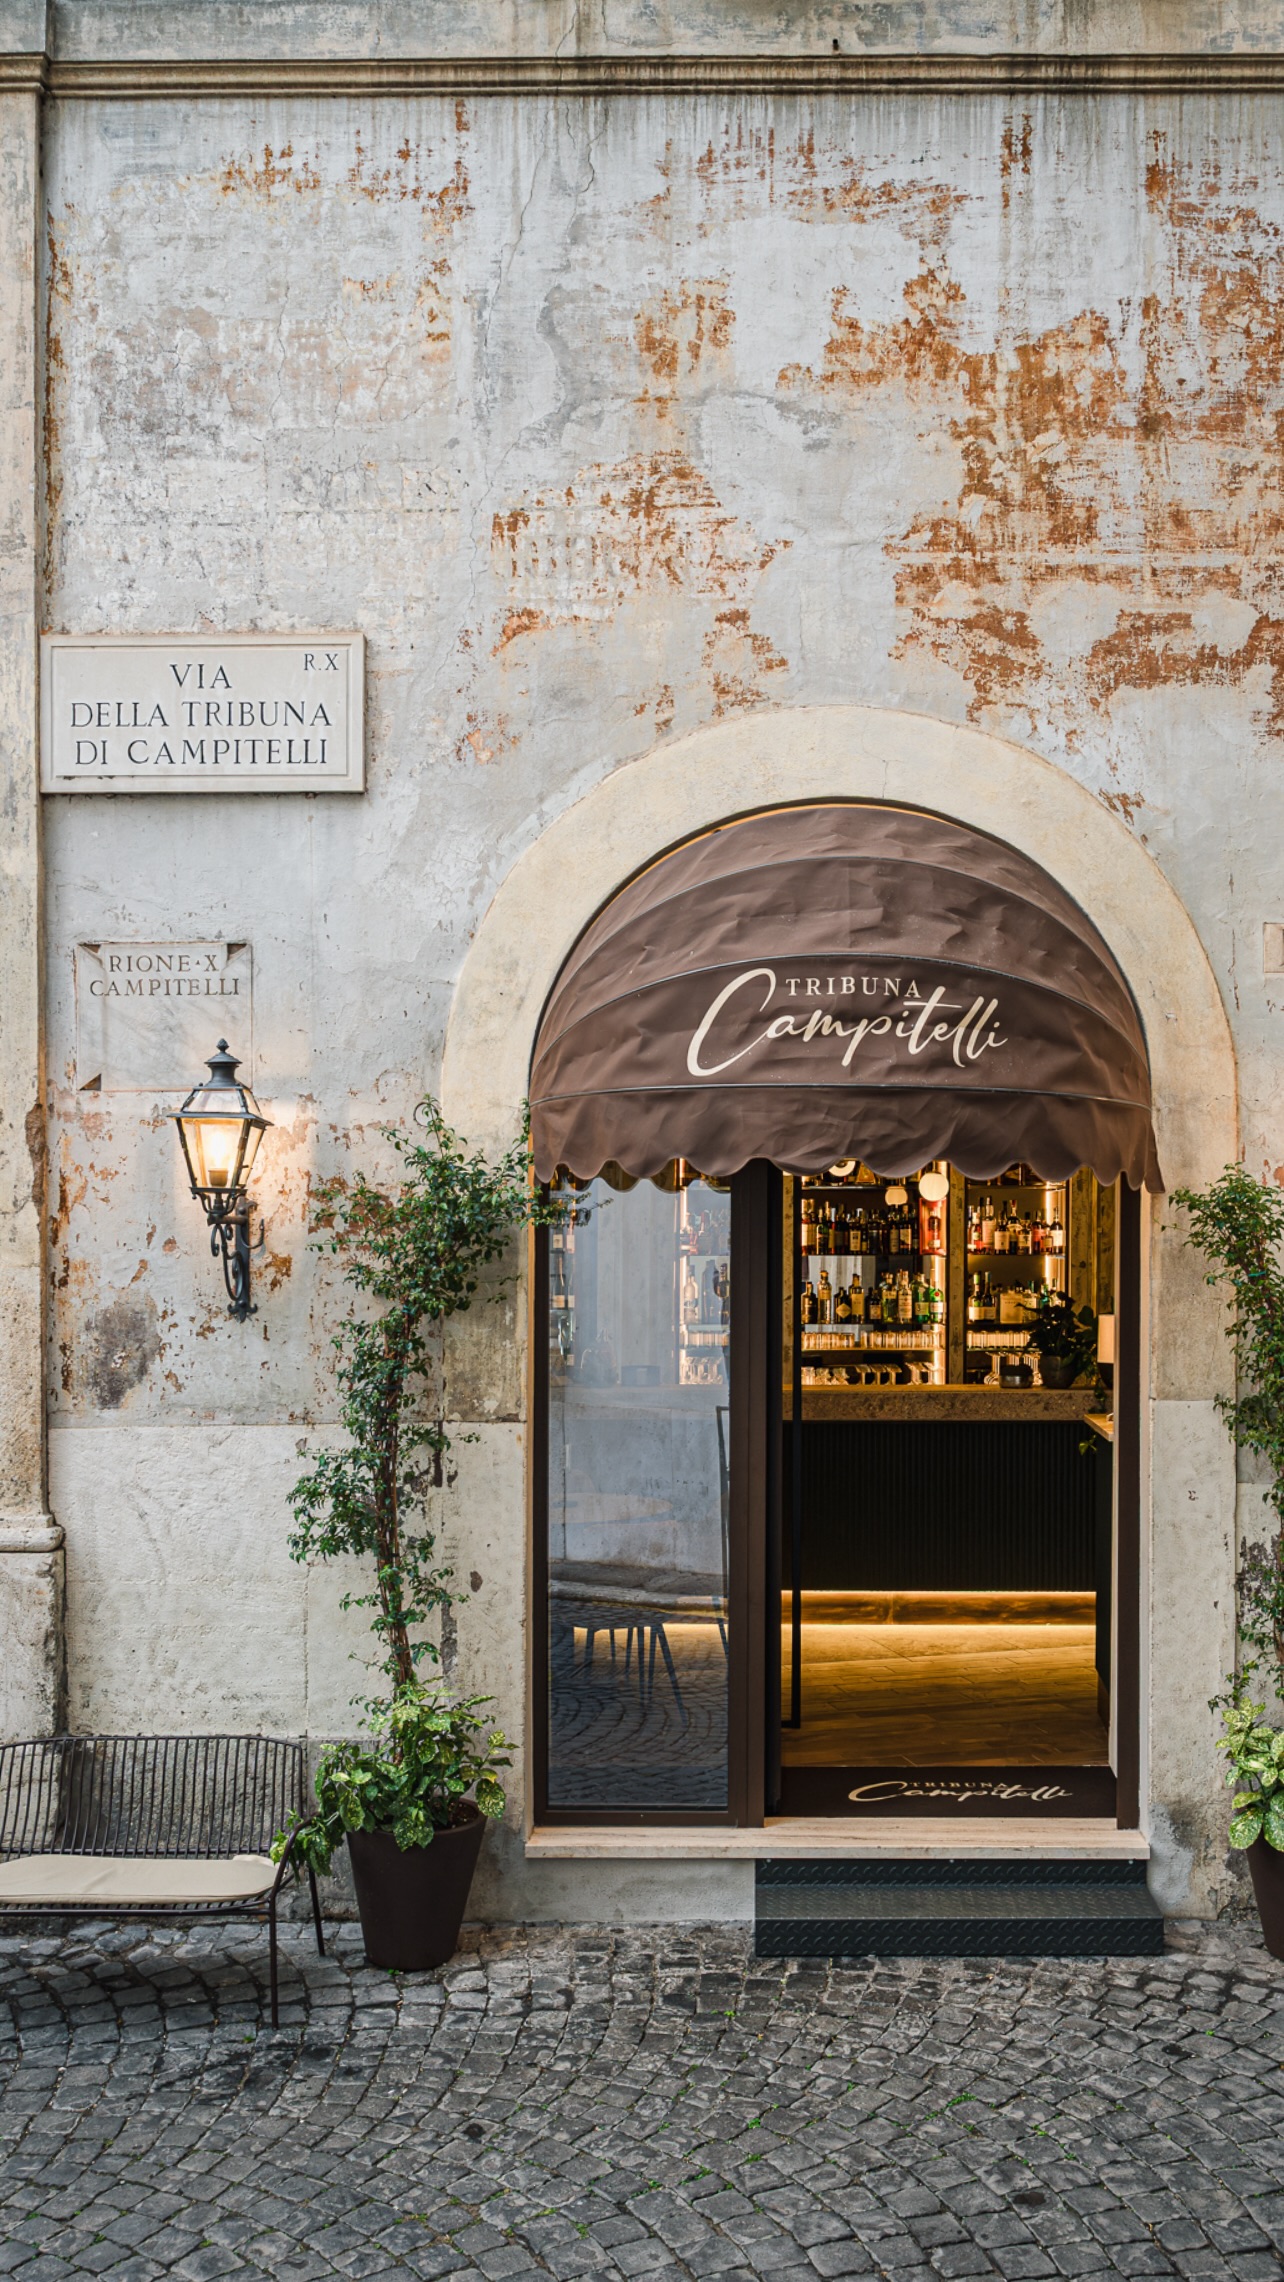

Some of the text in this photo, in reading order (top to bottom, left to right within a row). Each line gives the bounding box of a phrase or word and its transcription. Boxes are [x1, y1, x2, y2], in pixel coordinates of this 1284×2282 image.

[169, 663, 232, 689] VIA
[71, 701, 332, 727] DELLA TRIBUNA
[75, 739, 328, 765] DI CAMPITELLI
[89, 978, 240, 996] CAMPITELLI
[785, 976, 921, 998] TRIBUNA
[686, 967, 1008, 1077] Campitelli
[848, 1780, 1073, 1802] Campitelli
